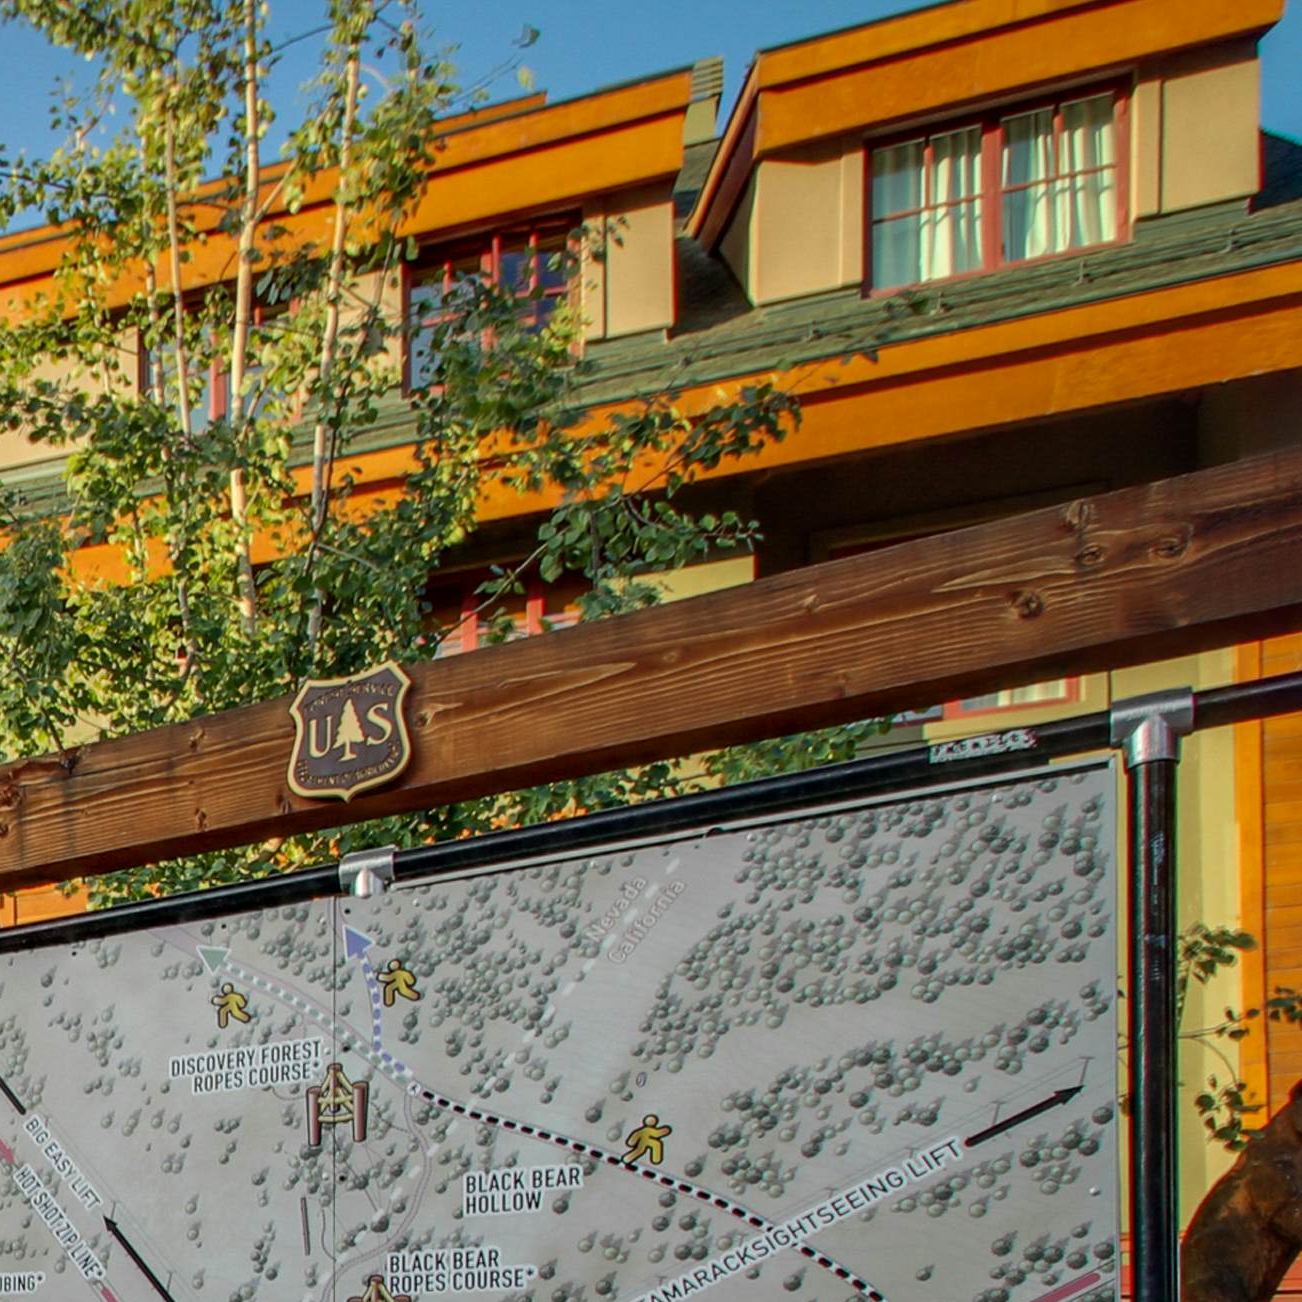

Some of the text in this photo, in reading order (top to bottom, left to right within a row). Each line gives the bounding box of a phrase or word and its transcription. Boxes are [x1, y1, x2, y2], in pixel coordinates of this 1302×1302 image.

[586, 877, 646, 943] Nevada
[607, 881, 686, 964] California
[172, 1040, 321, 1077] DISCOVERY FOREST
[194, 1071, 243, 1093] ROPES
[26, 1118, 100, 1208] BIG EASY LIFT
[907, 1139, 961, 1180] LIFT
[466, 1168, 580, 1194] BLACK BEAR
[16, 1167, 41, 1194] HOT
[34, 1191, 64, 1229] SHOT
[55, 1223, 78, 1249] ZIP
[466, 1192, 542, 1214] HOLLOW
[390, 1250, 499, 1273] BLACK BEAR
[390, 1274, 445, 1293] ROPES
